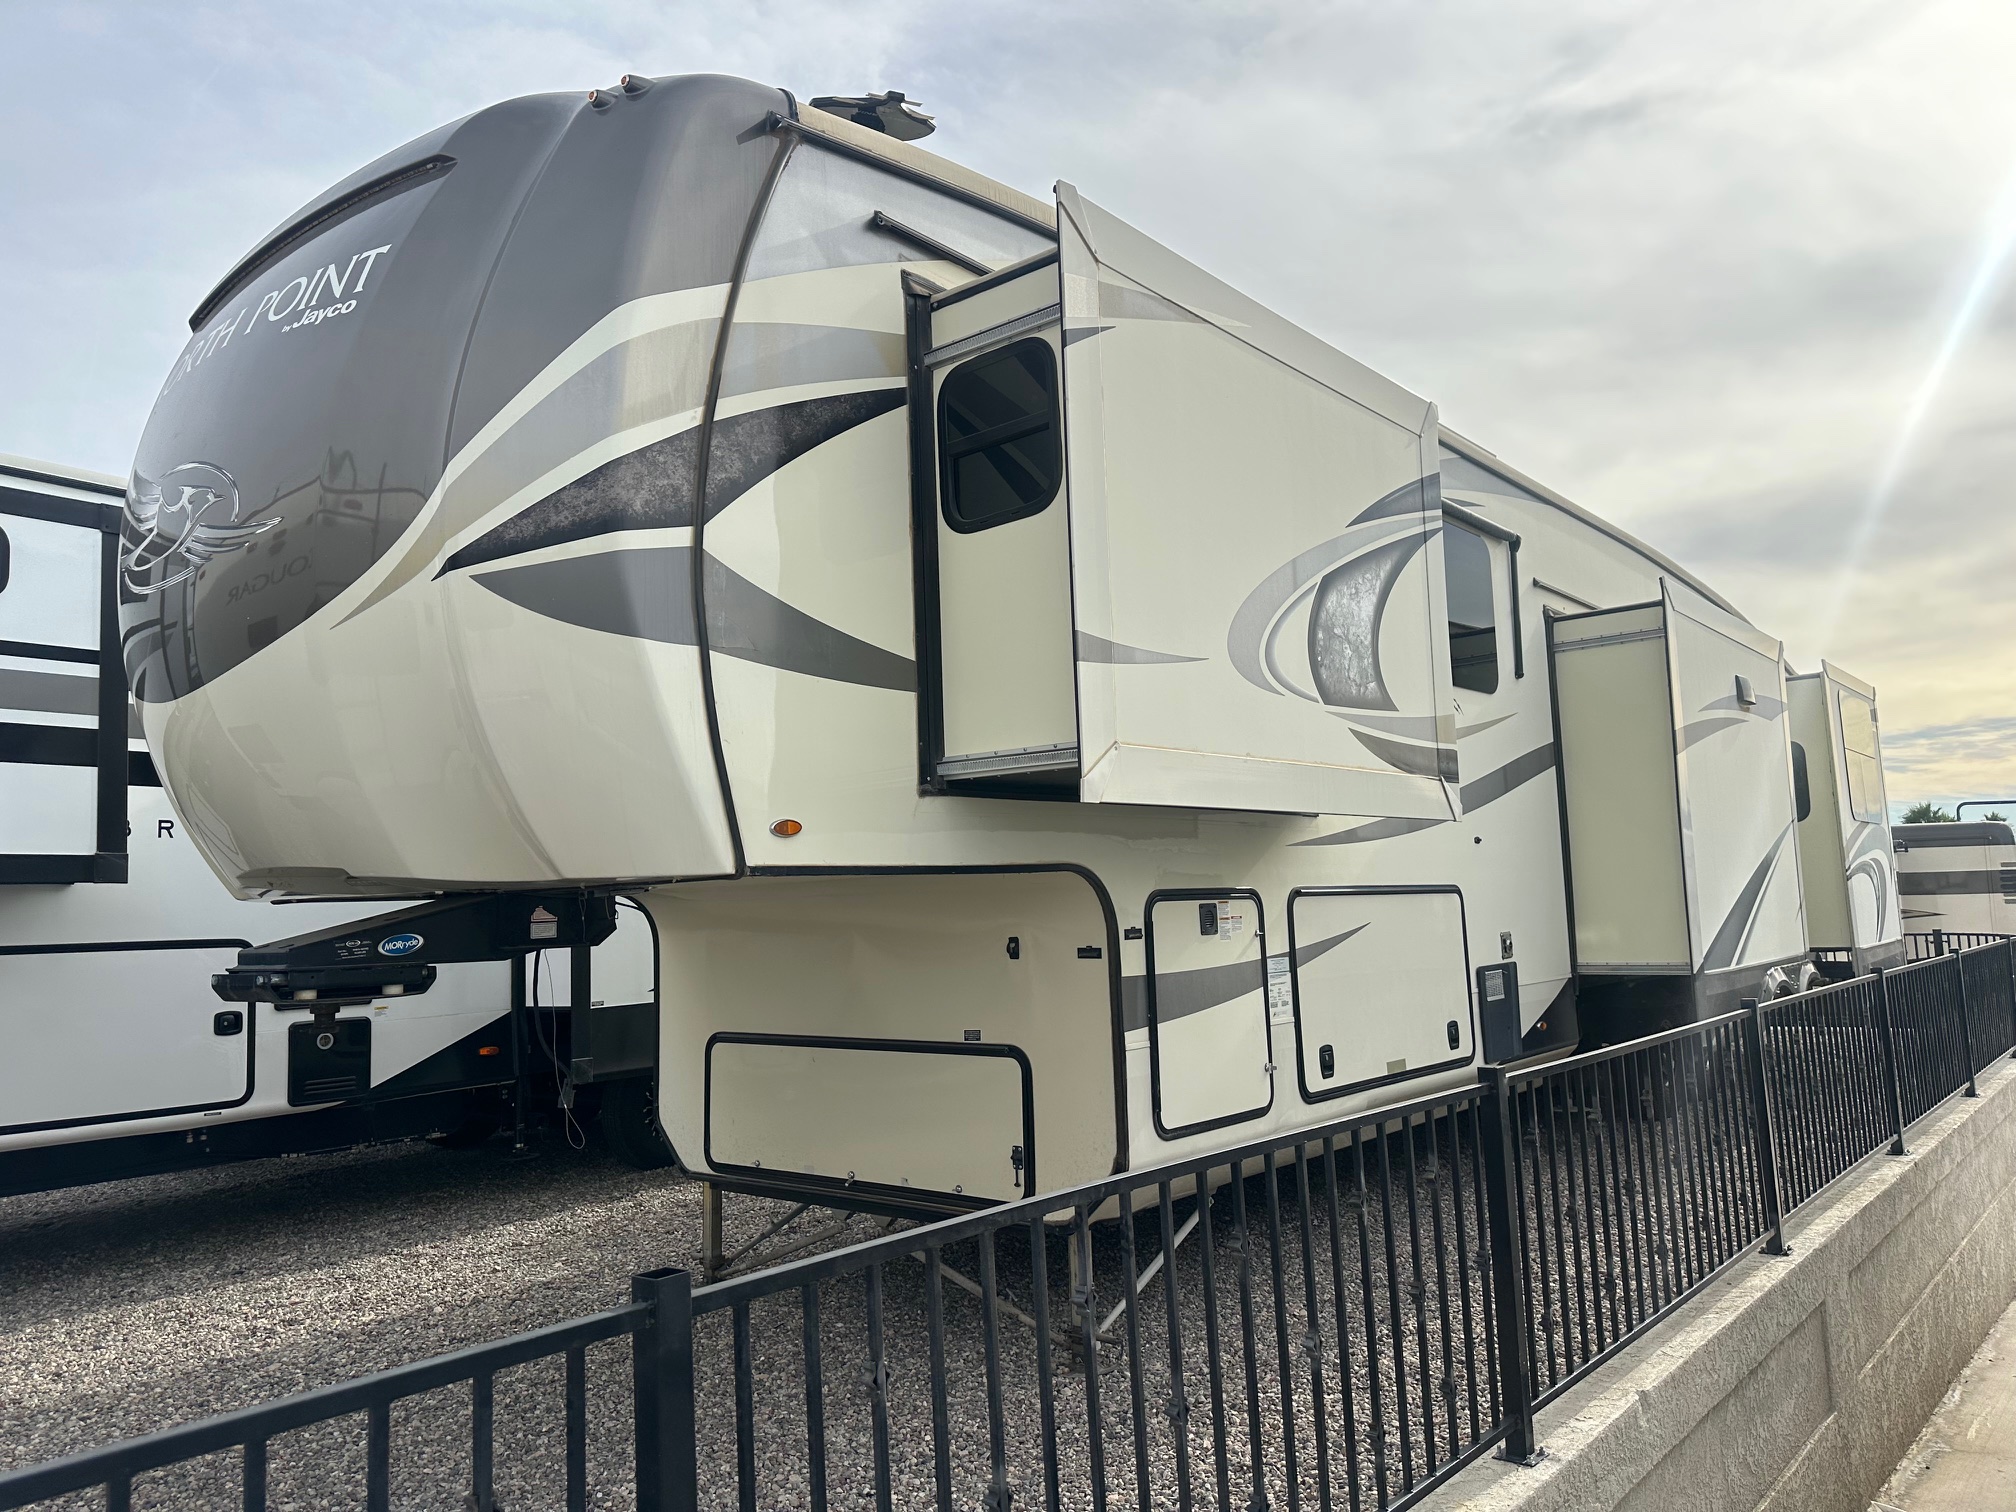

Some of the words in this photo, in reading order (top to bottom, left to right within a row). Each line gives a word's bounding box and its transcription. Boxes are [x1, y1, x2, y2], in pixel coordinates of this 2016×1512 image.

[163, 307, 248, 396] ORTH
[244, 244, 392, 335] POINT
[281, 324, 293, 333] by
[292, 299, 358, 329] Jayco
[384, 938, 419, 951] MORryde
